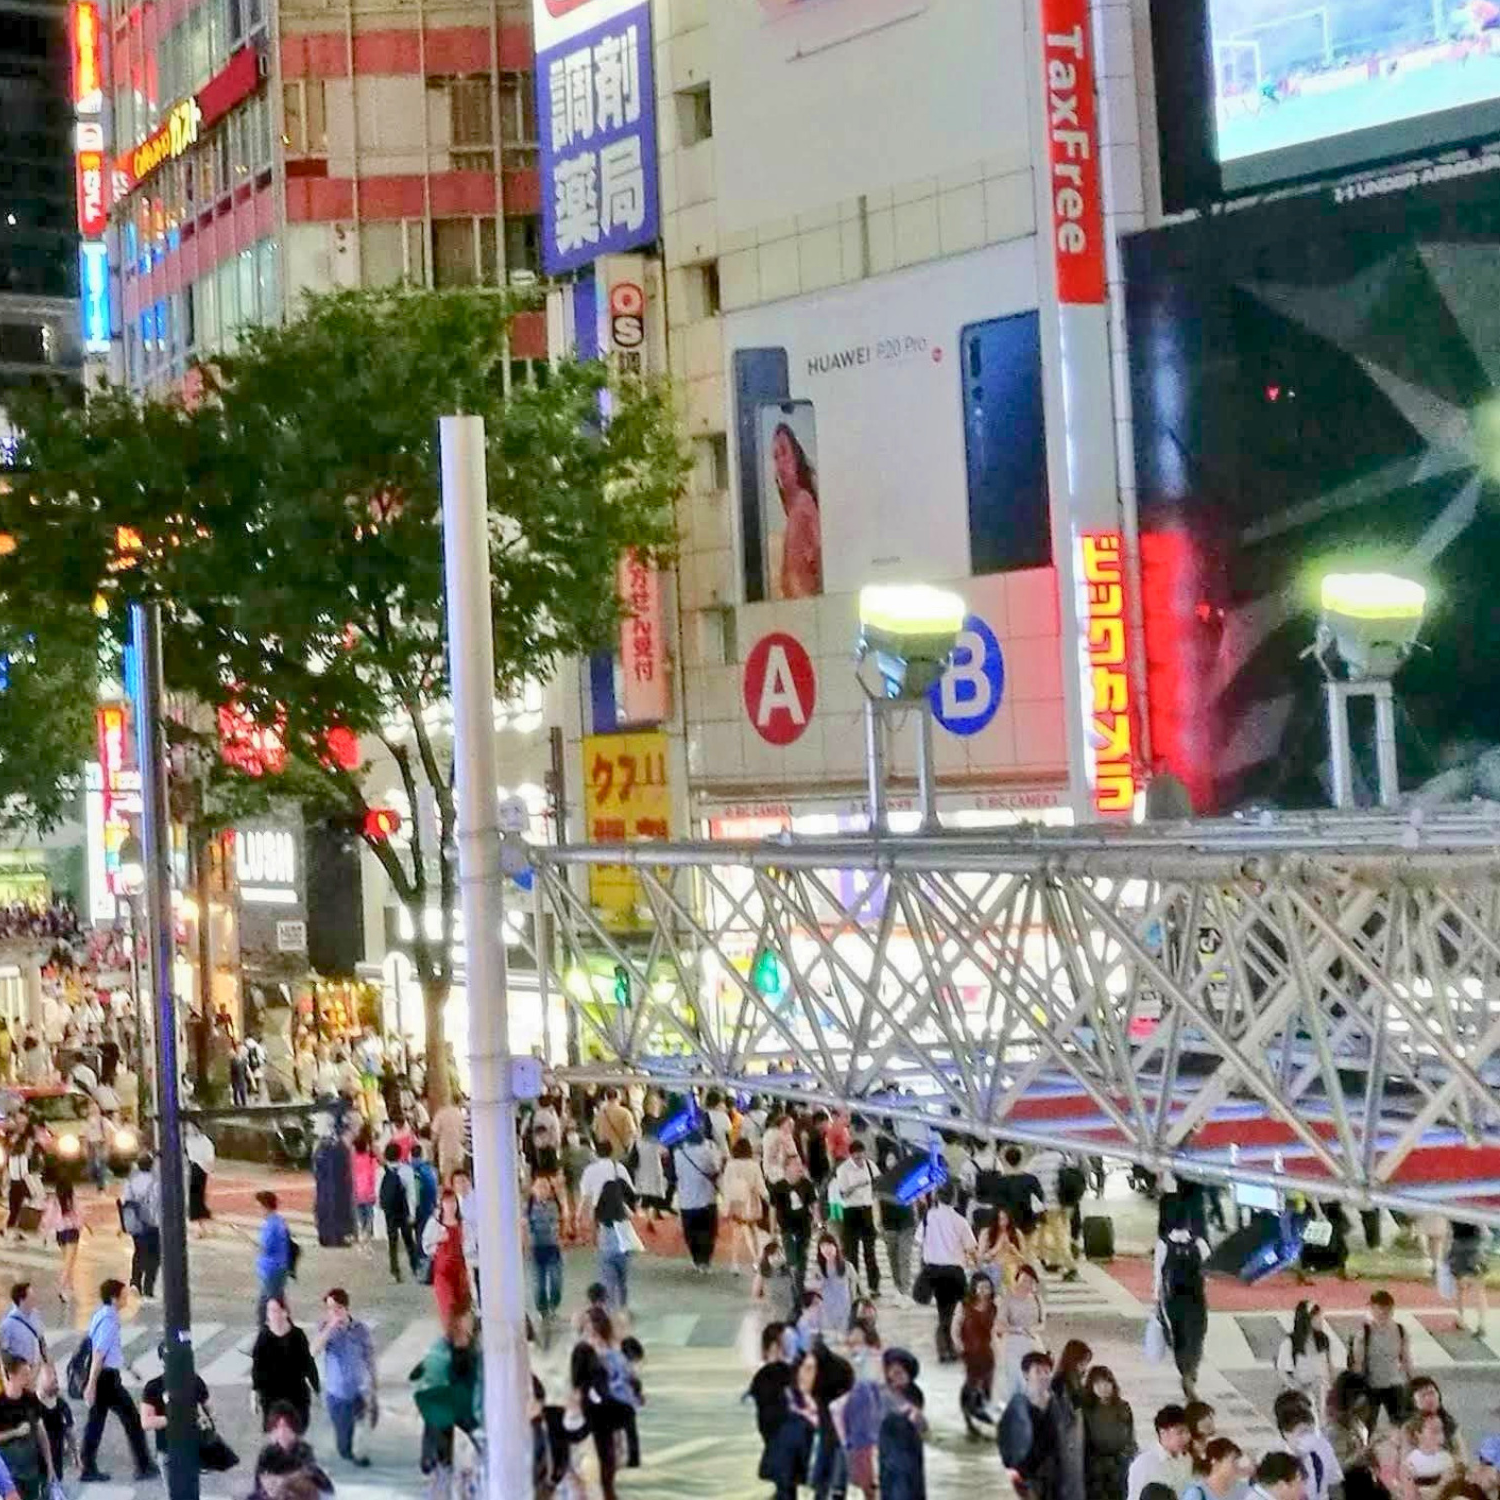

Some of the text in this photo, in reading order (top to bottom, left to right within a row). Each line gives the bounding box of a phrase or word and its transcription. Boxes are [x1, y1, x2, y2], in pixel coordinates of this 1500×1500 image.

[550, 24, 641, 153] 調剤
[1045, 25, 1090, 255] TaxFree
[553, 134, 645, 256] 薬局
[610, 283, 644, 348] OS
[808, 346, 870, 375] HUAWEI
[756, 645, 806, 726] A
[941, 631, 991, 718] B
[1083, 534, 1134, 812] ビックカメラ
[235, 830, 294, 883] LUSH
